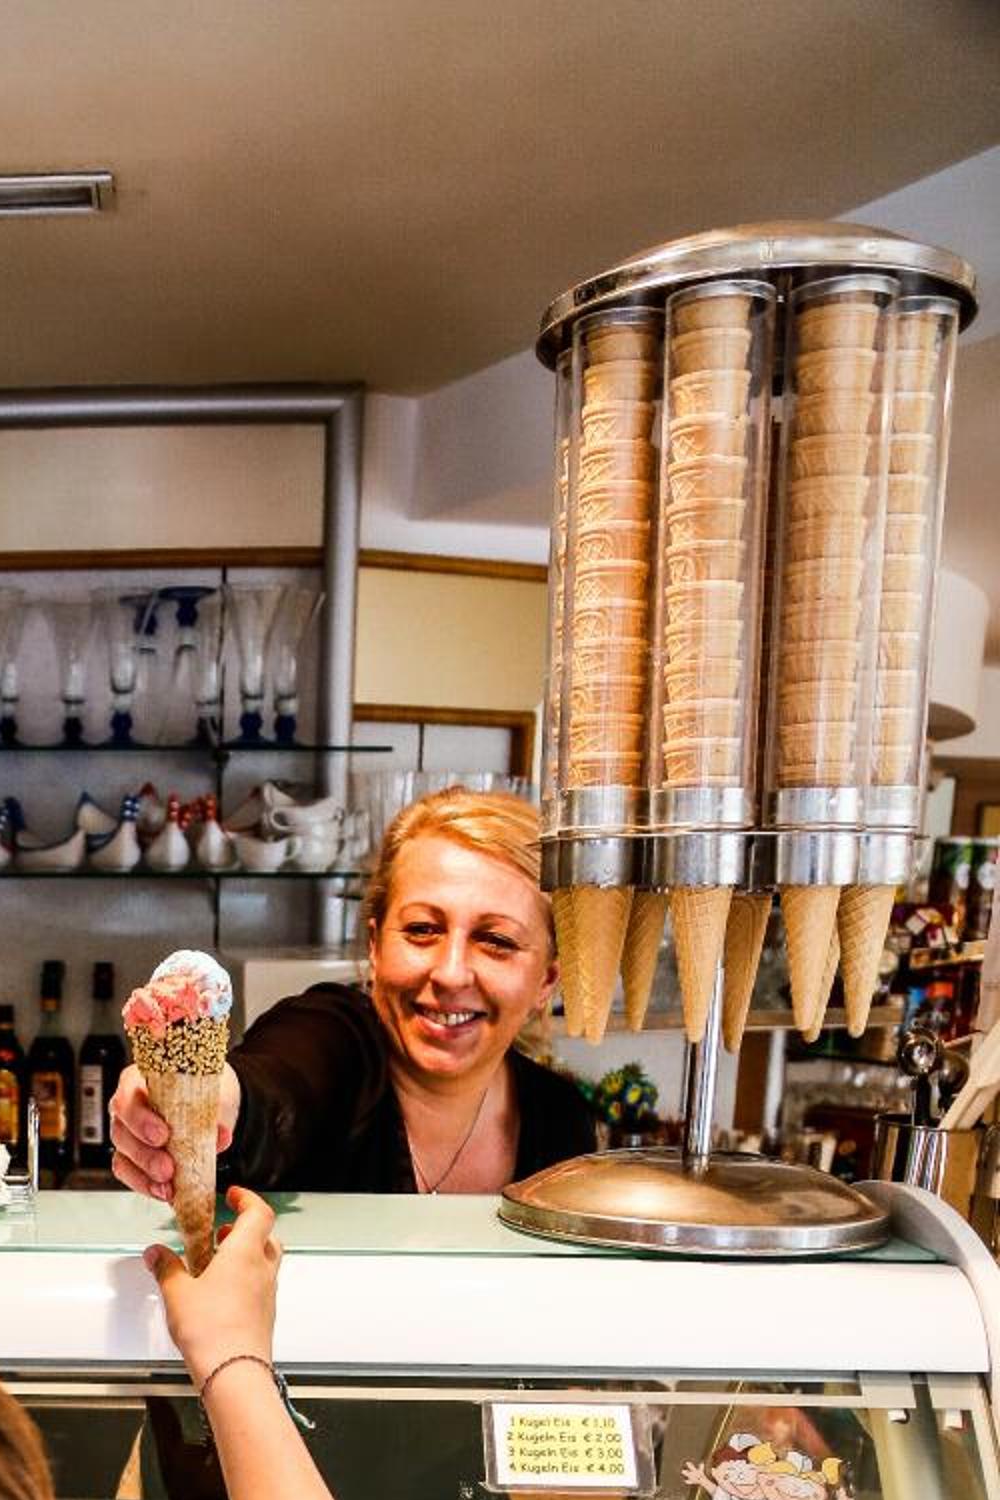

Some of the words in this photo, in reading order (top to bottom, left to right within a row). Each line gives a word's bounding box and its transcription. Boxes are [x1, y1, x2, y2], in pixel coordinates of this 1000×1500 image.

[519, 1417, 551, 1428] Kugel
[553, 1417, 571, 1427] Eis
[582, 1418, 589, 1427] €
[518, 1431, 557, 1445] Kugeln
[559, 1432, 577, 1442] Eis
[583, 1432, 592, 1442] €
[519, 1447, 557, 1460] Kugeln
[560, 1447, 578, 1458] Eis
[585, 1448, 593, 1458] €
[521, 1462, 559, 1474] Kugeln
[561, 1462, 579, 1473] Eis
[587, 1463, 595, 1473] €
